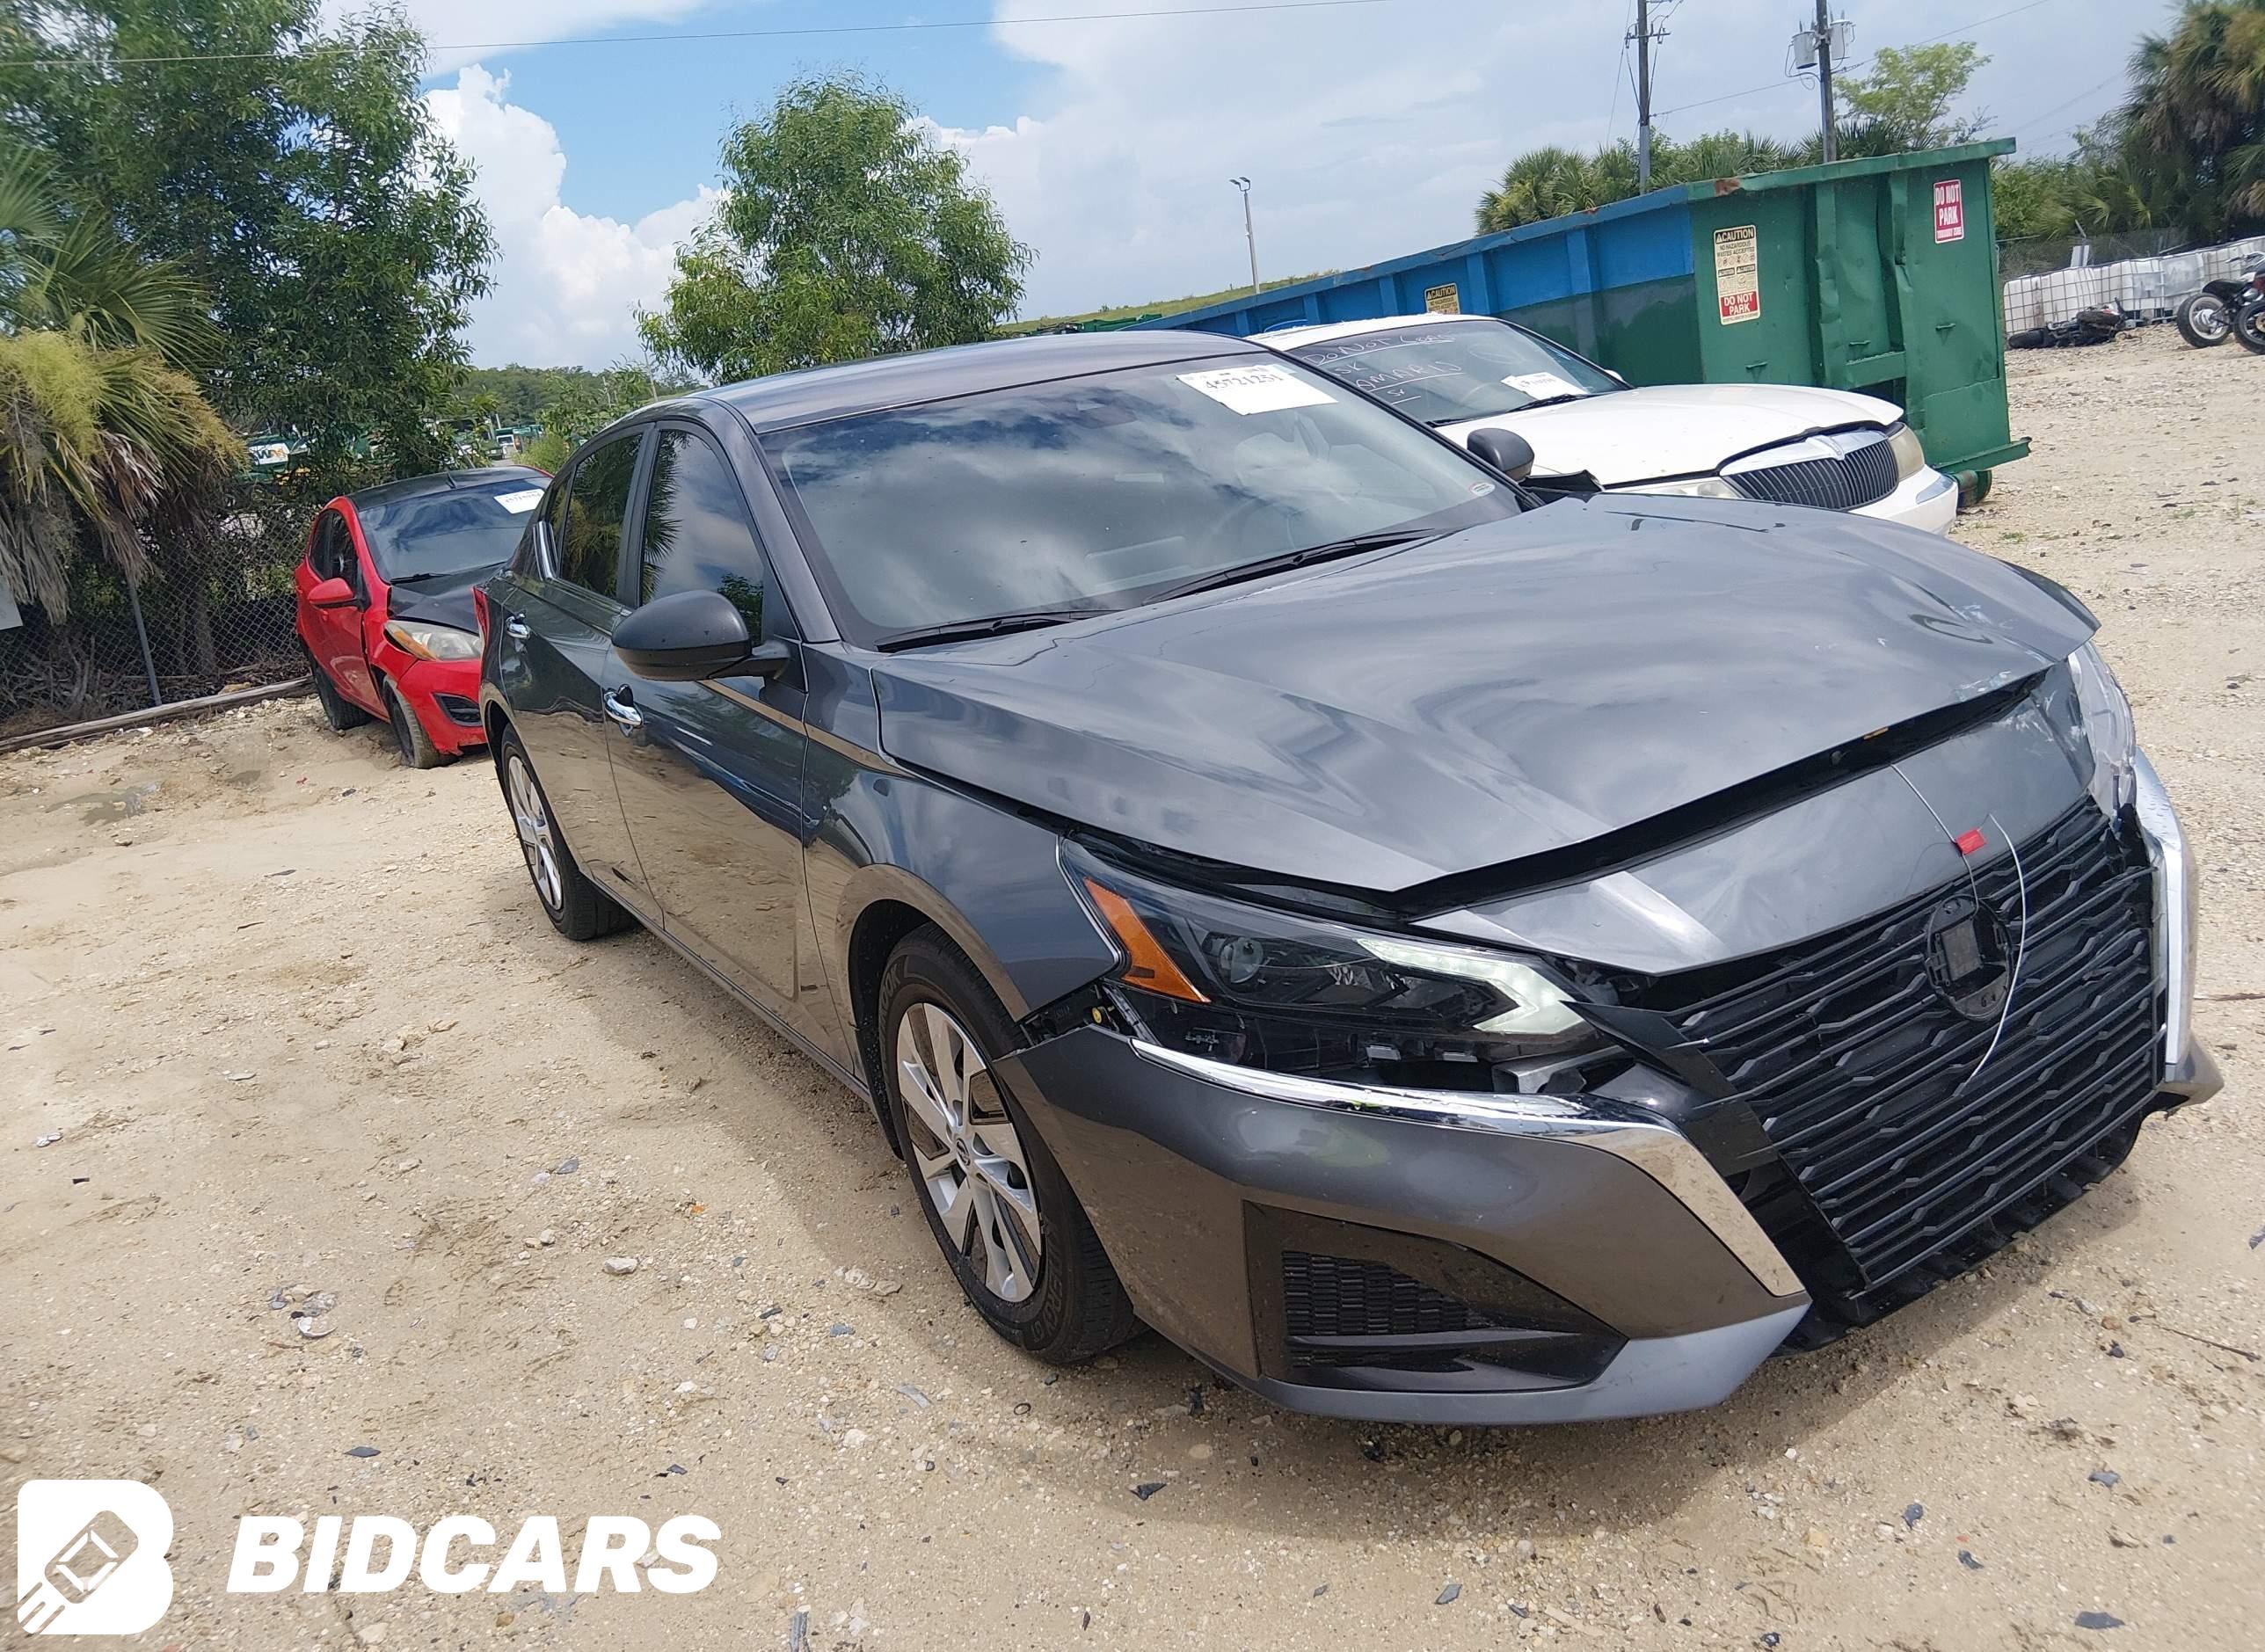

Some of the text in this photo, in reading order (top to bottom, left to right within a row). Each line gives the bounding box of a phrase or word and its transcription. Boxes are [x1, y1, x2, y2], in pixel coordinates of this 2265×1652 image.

[1935, 184, 1959, 206] DO NOT
[1939, 206, 1958, 226] PARK
[1722, 228, 1754, 242] CAUTION
[1431, 287, 1455, 298] CAUTION
[1724, 292, 1753, 307] DO NOT
[1729, 302, 1750, 316] PARK
